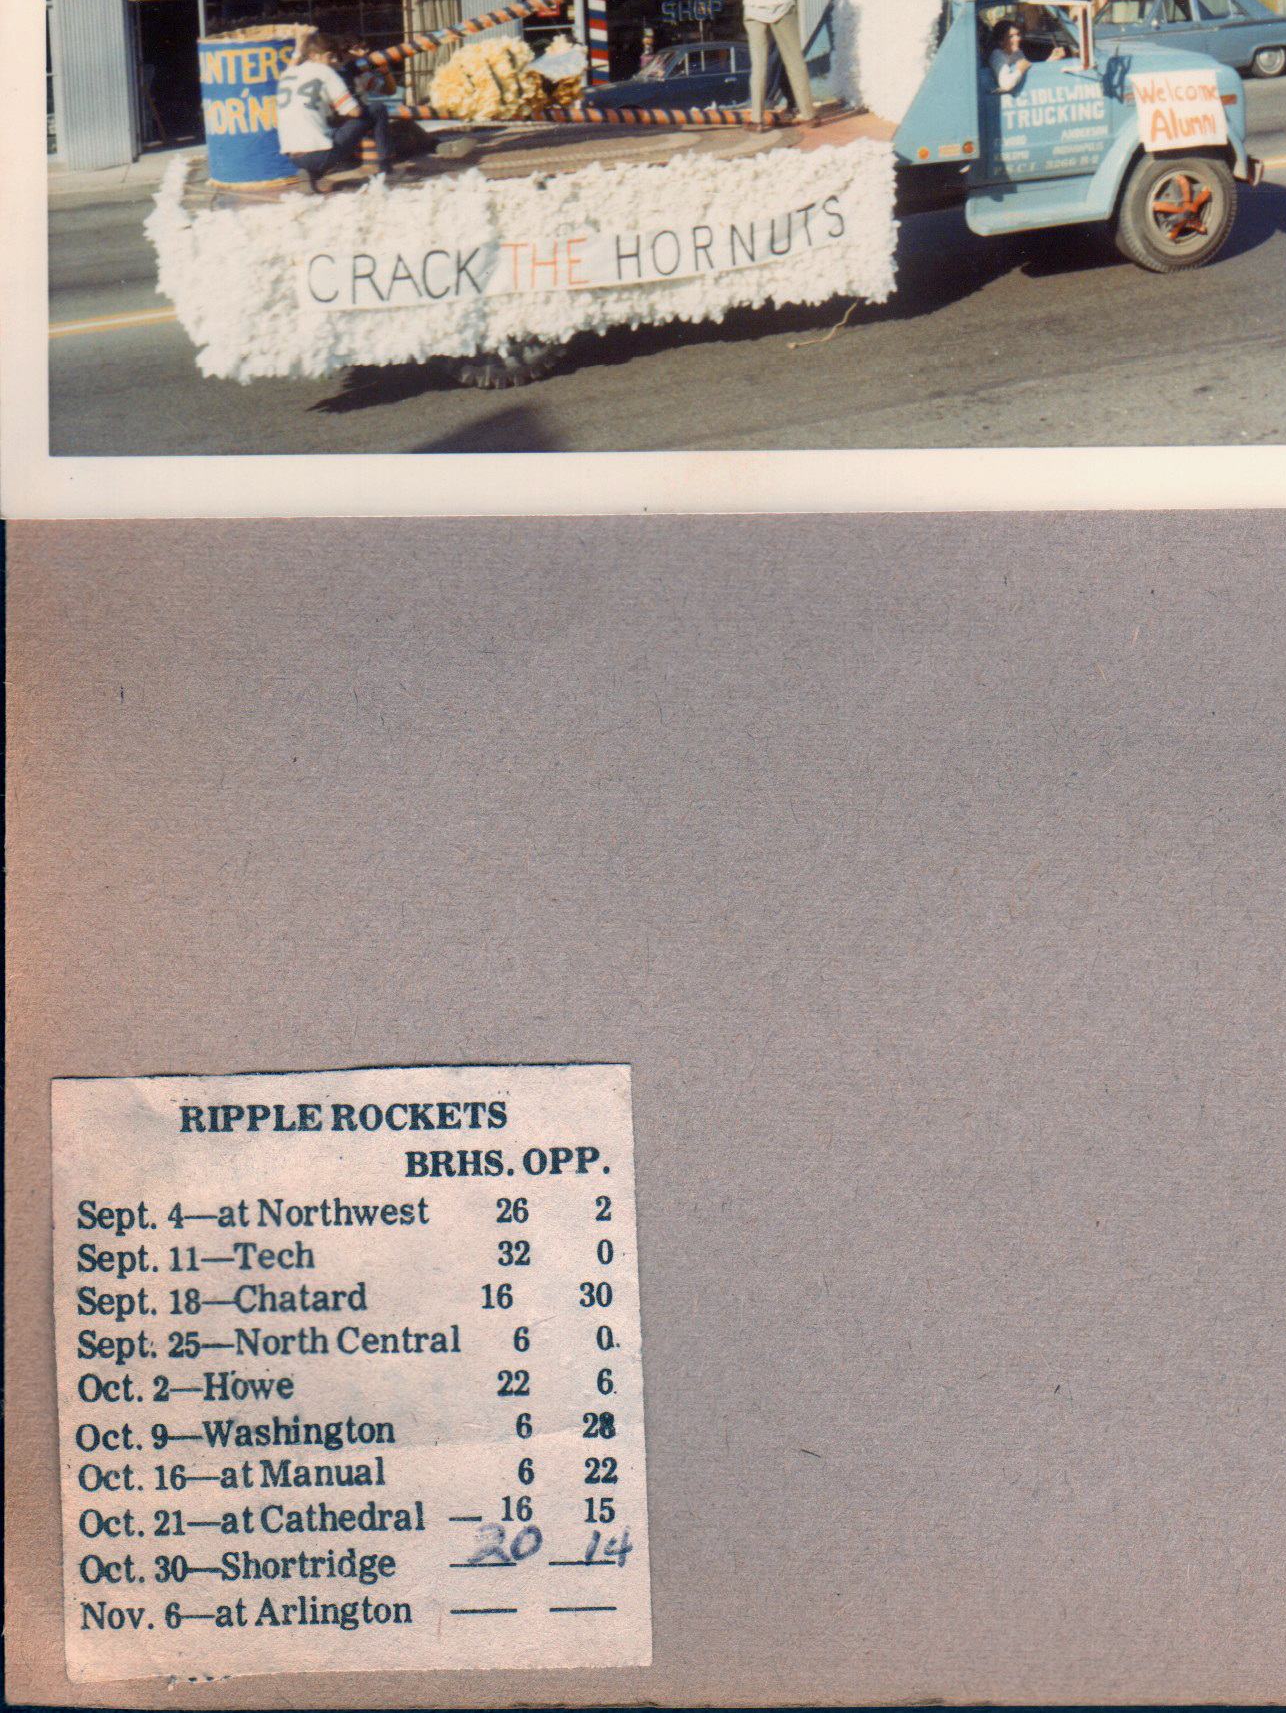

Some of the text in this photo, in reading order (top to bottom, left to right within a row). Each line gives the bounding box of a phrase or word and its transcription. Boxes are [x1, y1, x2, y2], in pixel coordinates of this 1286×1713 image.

[661, 0, 723, 22] SHOP
[277, 76, 325, 109] 54
[1132, 79, 1219, 105] Welcome
[1003, 101, 1105, 130] TRUCKING
[1151, 107, 1217, 143] Alumni
[307, 247, 483, 305] CRACK
[501, 237, 589, 291] THE
[180, 1102, 507, 1132] RIPPLE ROCKETS
[405, 1147, 609, 1177] BRHS. OPP.
[78, 1201, 156, 1236] Sept.
[258, 1198, 429, 1226] Northwest
[497, 1198, 528, 1223] 26
[596, 1196, 611, 1221] 2
[78, 1244, 158, 1279] Sept.
[498, 1241, 530, 1266] 32
[597, 1240, 613, 1264] 0
[77, 1286, 156, 1322] Sept.
[482, 1284, 513, 1309] 16
[580, 1282, 612, 1307] 30
[78, 1330, 156, 1365] Sept.
[337, 1325, 460, 1354] Central
[514, 1327, 529, 1352] 6
[78, 1373, 142, 1402] Oct.
[498, 1370, 529, 1397] 22
[597, 1369, 613, 1395] 6
[76, 1424, 142, 1452] Oct.
[516, 1413, 532, 1439] 6
[78, 1464, 143, 1492] Oct.
[260, 1457, 385, 1487] Manual
[518, 1458, 534, 1485] 6
[585, 1457, 618, 1484] 22
[79, 1509, 144, 1538] Oct.
[261, 1501, 425, 1533] Cathedral
[502, 1496, 532, 1522] 16
[585, 1497, 615, 1523] 15
[585, 1525, 633, 1567] 14
[78, 1555, 144, 1584] Oct.
[81, 1602, 153, 1629] Nov.
[255, 1596, 412, 1630] Arlington
